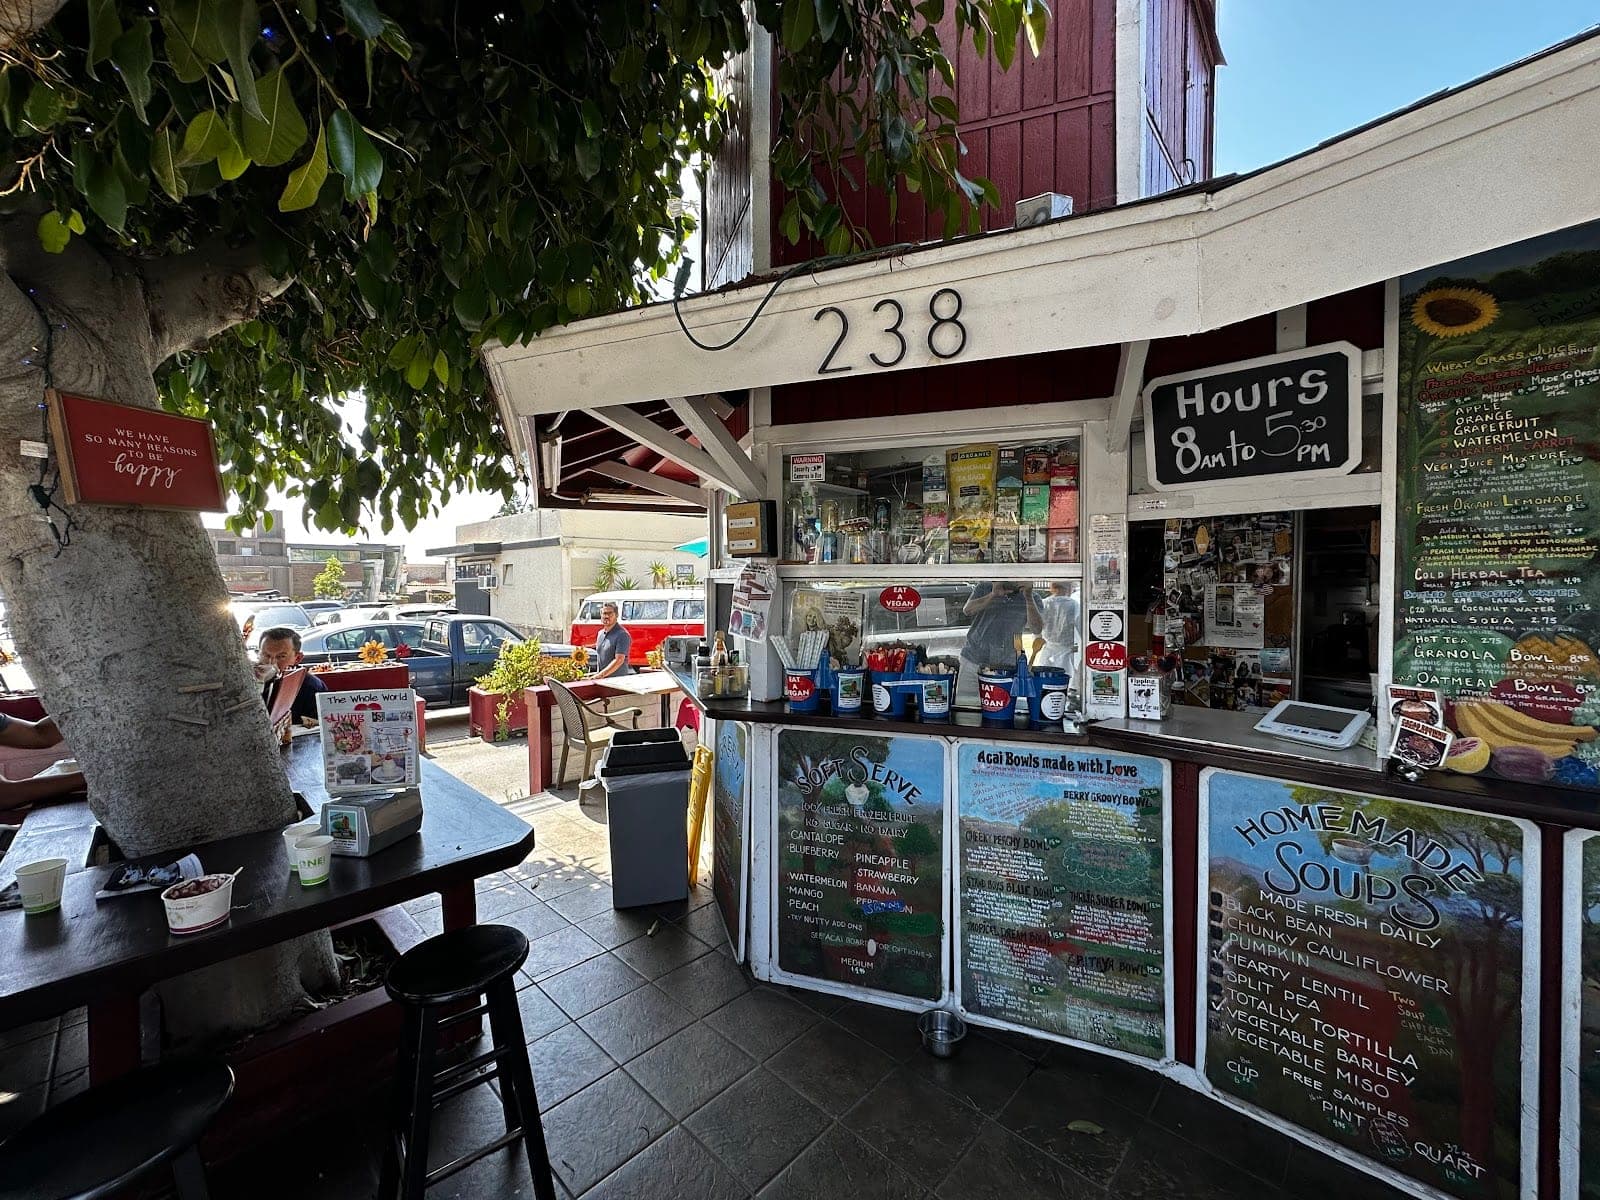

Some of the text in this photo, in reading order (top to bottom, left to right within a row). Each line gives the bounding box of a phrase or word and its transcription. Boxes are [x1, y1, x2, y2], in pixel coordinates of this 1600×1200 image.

[814, 288, 967, 374] 238
[1427, 343, 1577, 374] WHEAT GRASS JUICE
[1176, 369, 1329, 419] Hours
[1455, 402, 1501, 416] APPLE
[1456, 409, 1513, 425] ORANGE
[1453, 416, 1541, 436] GRAPEFRUIT
[115, 428, 170, 444] WE HAVE
[1453, 427, 1558, 449] WATERMELON
[1523, 436, 1576, 450] CARROT
[85, 434, 198, 457] SO MANY REASONS
[128, 450, 164, 462] TO BE
[793, 456, 823, 464] WARNING
[960, 451, 992, 459] ORGANIC
[1423, 450, 1568, 472] VEGI JUICE MIXTURE
[108, 452, 182, 489] happy
[1417, 493, 1584, 515] FRESH ORGANIC LEMONADE
[1535, 537, 1587, 546] LEMONADE
[1550, 544, 1599, 552] LEMONADE
[1414, 566, 1546, 581] COLD HERBAL TEA
[886, 600, 915, 608] VEGAN
[1431, 604, 1457, 613] PURE
[1461, 603, 1509, 613] COCONUT
[1513, 605, 1557, 614] WATER
[1404, 615, 1458, 624] NATURAL
[1468, 615, 1515, 624] SODA
[1415, 635, 1469, 644] HOT TEA
[1090, 658, 1124, 666] VEGAN
[1414, 646, 1496, 661] GRANOLA
[1510, 649, 1554, 663] BOWL
[1417, 671, 1562, 694] OATMEAL BOWL
[327, 692, 408, 705] The Whole World
[332, 713, 365, 723] Living
[978, 751, 1003, 765] Acai
[1005, 752, 1040, 768] Bowls
[1042, 756, 1075, 772] made
[1077, 758, 1104, 774] with
[797, 758, 845, 795] SOFT
[847, 745, 923, 806] SERVE
[1063, 790, 1153, 808] BERRY GROOVY BOWL
[790, 829, 845, 846] CANTALOPE
[1023, 838, 1050, 851] BOWL
[789, 843, 840, 859] BLUEBERRY
[1233, 805, 1485, 893] HOMEMADE
[855, 853, 910, 869] PINEAPPLE
[789, 872, 848, 889] WATERMELON
[857, 868, 920, 885] STRAWBERRY
[789, 886, 824, 899] MANGO
[856, 883, 897, 897] BANANA
[1264, 840, 1442, 931] SOUPS
[789, 899, 820, 912] PEACH
[803, 912, 863, 931] NUTTY ADD ONS
[1226, 899, 1332, 939] BLACK BEAN
[1260, 889, 1442, 949] MADE FRESH DAILY
[1227, 916, 1452, 995] CHUNKY CAULIFLOWER
[1228, 933, 1310, 968] PUMPKIN
[841, 957, 874, 970] MEDIUM
[1226, 951, 1371, 1010] HEARTY LENTIL
[1227, 971, 1321, 1013] SPLIT PEA
[1388, 990, 1415, 1006] TWO
[1397, 1004, 1425, 1021] SOUP
[1227, 987, 1419, 1070] TOTALLY TORTILLA
[1227, 1006, 1416, 1088] VEGETABLE BARLEY
[1416, 1032, 1446, 1046] EACH
[1428, 1045, 1455, 1058] DAY
[1226, 1022, 1390, 1099] VEGETABLE MISO
[1226, 1061, 1260, 1080] CUP
[1282, 1067, 1323, 1091] FREE
[1332, 1088, 1409, 1128] SAMPLES
[1322, 1100, 1366, 1127] PINT
[1414, 1141, 1486, 1180] QUART
